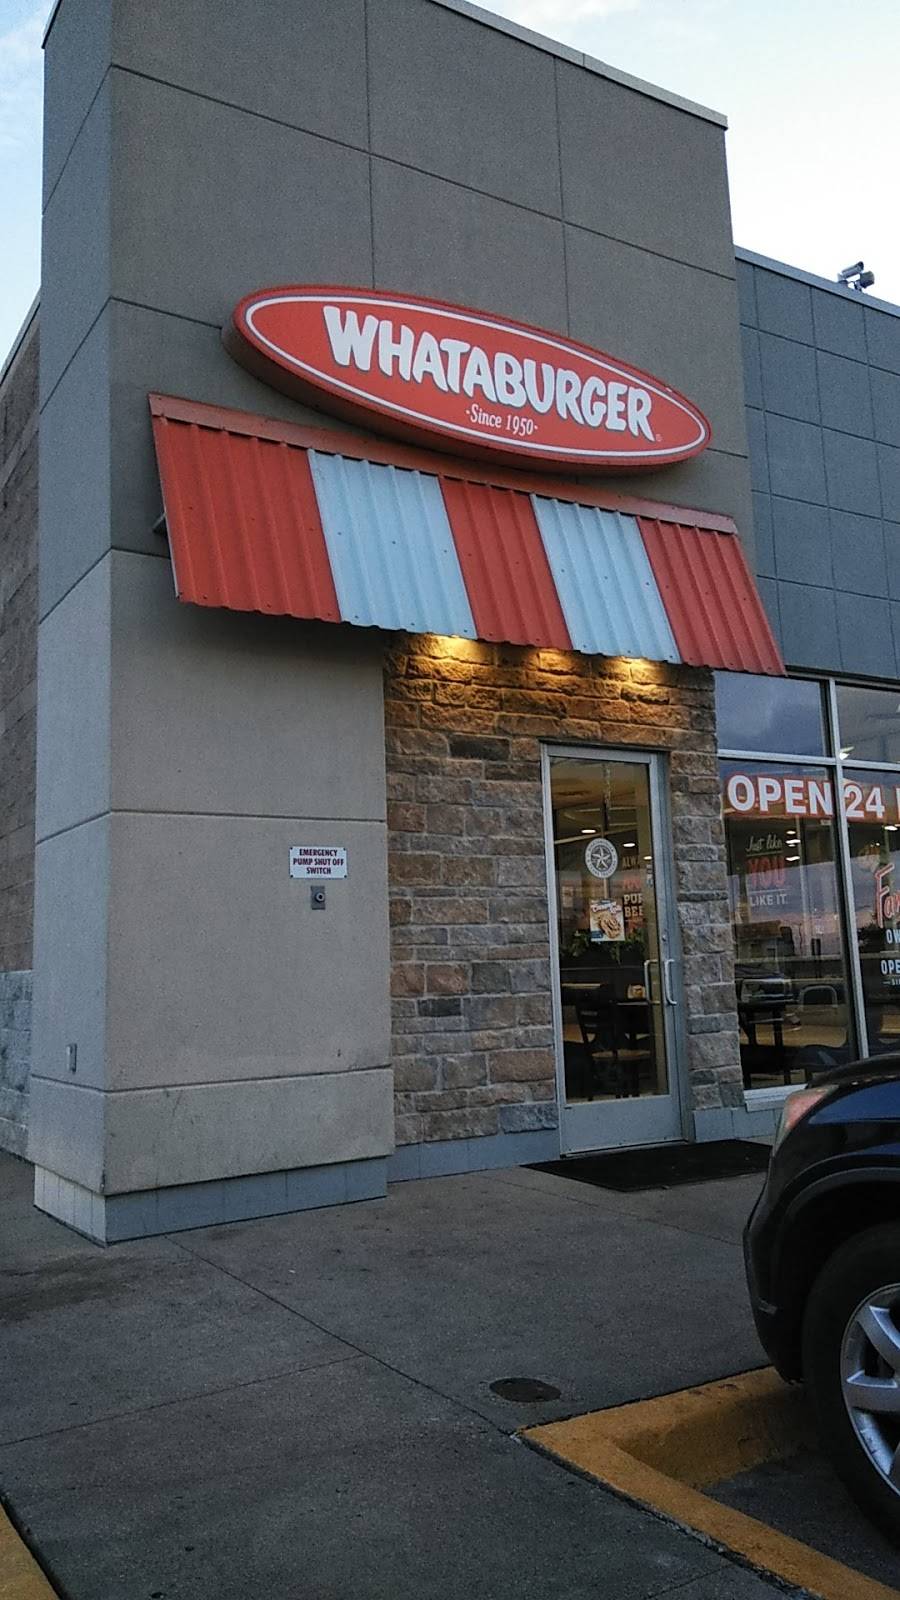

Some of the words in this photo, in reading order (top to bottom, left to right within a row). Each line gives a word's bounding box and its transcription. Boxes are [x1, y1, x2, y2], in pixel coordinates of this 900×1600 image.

[323, 305, 656, 442] WHATABURGER
[470, 404, 502, 428] Since
[506, 414, 534, 437] 1950
[727, 774, 834, 816] OPEN
[844, 784, 885, 819] 24
[293, 858, 313, 866] PUMP
[314, 858, 331, 866] SHUT
[332, 858, 344, 866] OFF
[299, 848, 338, 857] EMERGENCY
[747, 856, 785, 889] YOU
[750, 894, 774, 907] LIKE
